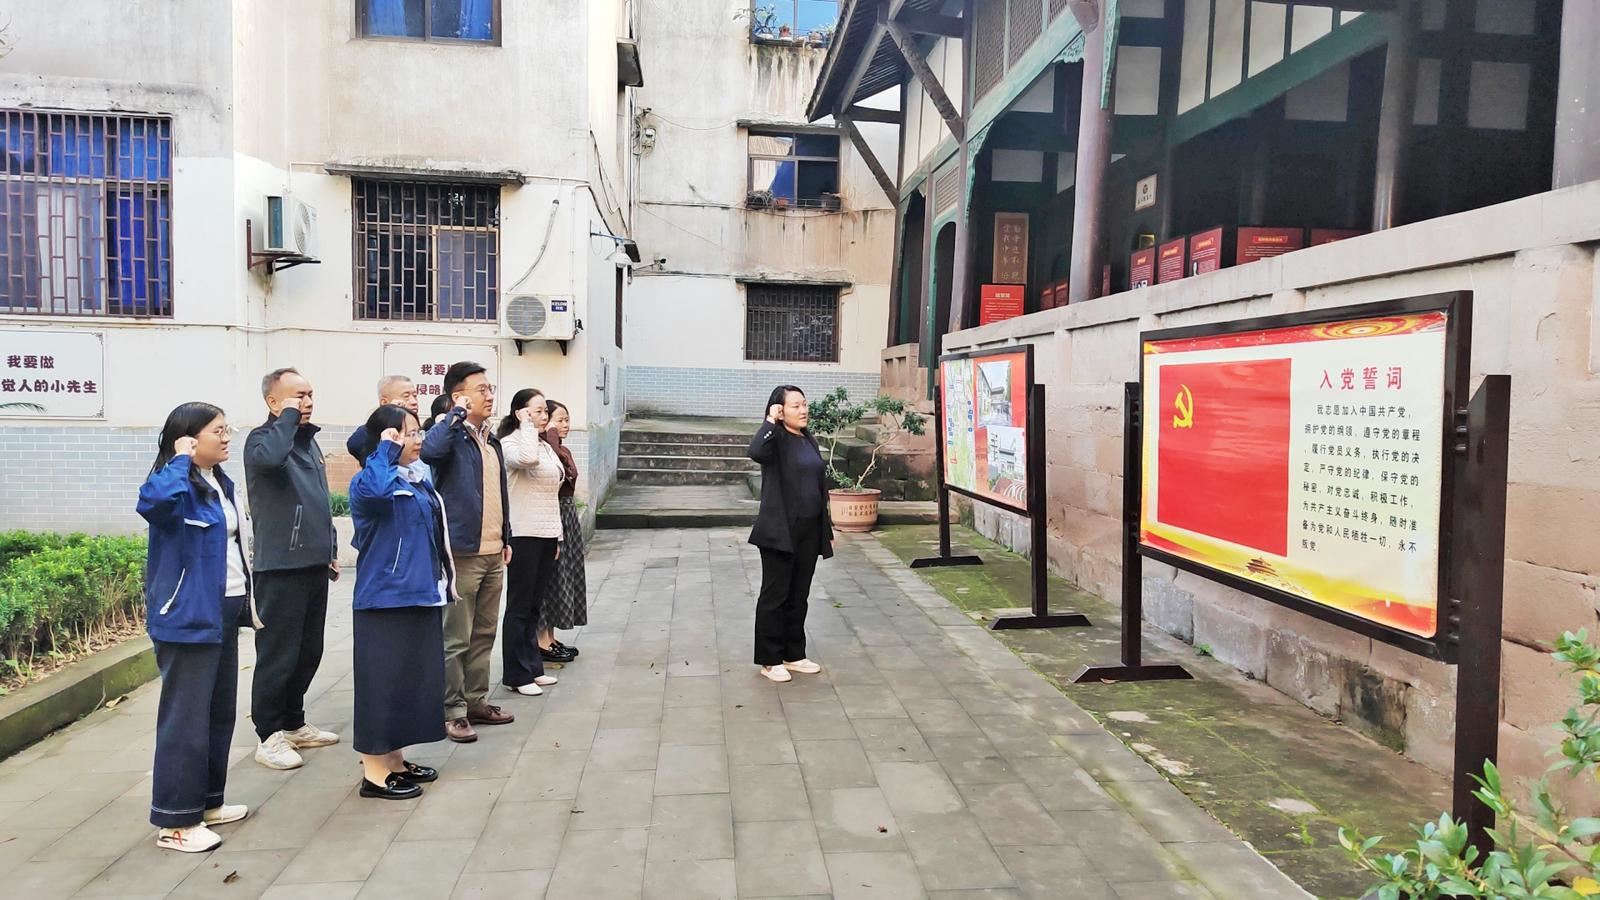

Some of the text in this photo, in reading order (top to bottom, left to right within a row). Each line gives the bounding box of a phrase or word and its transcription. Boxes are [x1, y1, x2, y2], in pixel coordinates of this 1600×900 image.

[7, 355, 55, 369] 我要做
[421, 363, 453, 376] 我要
[1319, 367, 1403, 390] 入党誓词
[1, 379, 97, 393] 觉人的小先生
[416, 384, 445, 396] 侵略
